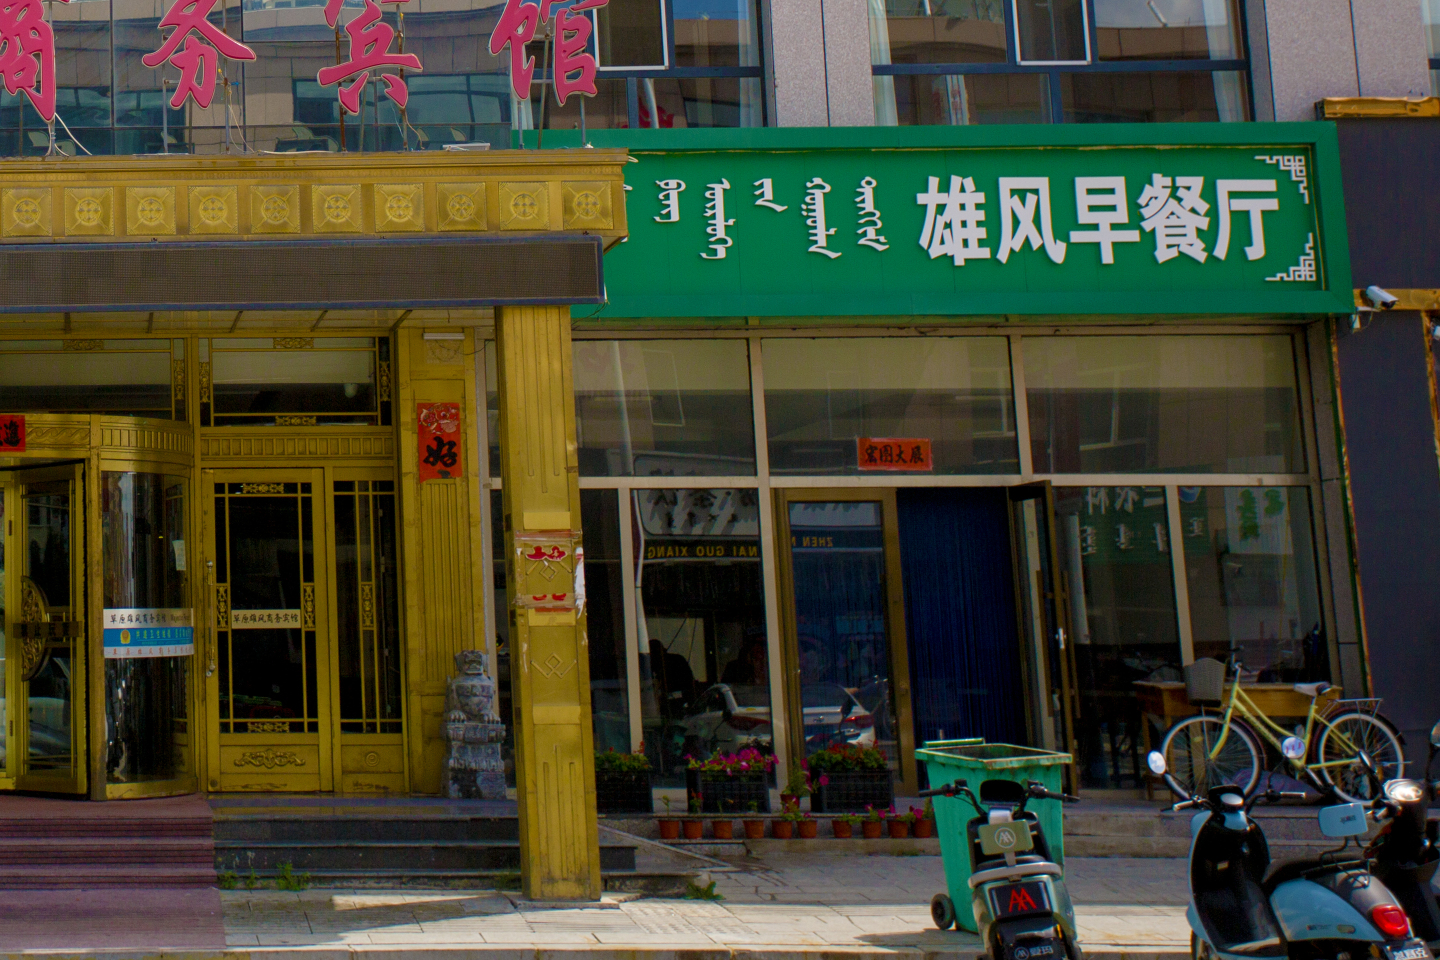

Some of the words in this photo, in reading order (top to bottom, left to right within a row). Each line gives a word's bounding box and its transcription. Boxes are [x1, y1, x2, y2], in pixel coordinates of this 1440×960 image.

[916, 172, 1280, 267] 雄风早餐厅
